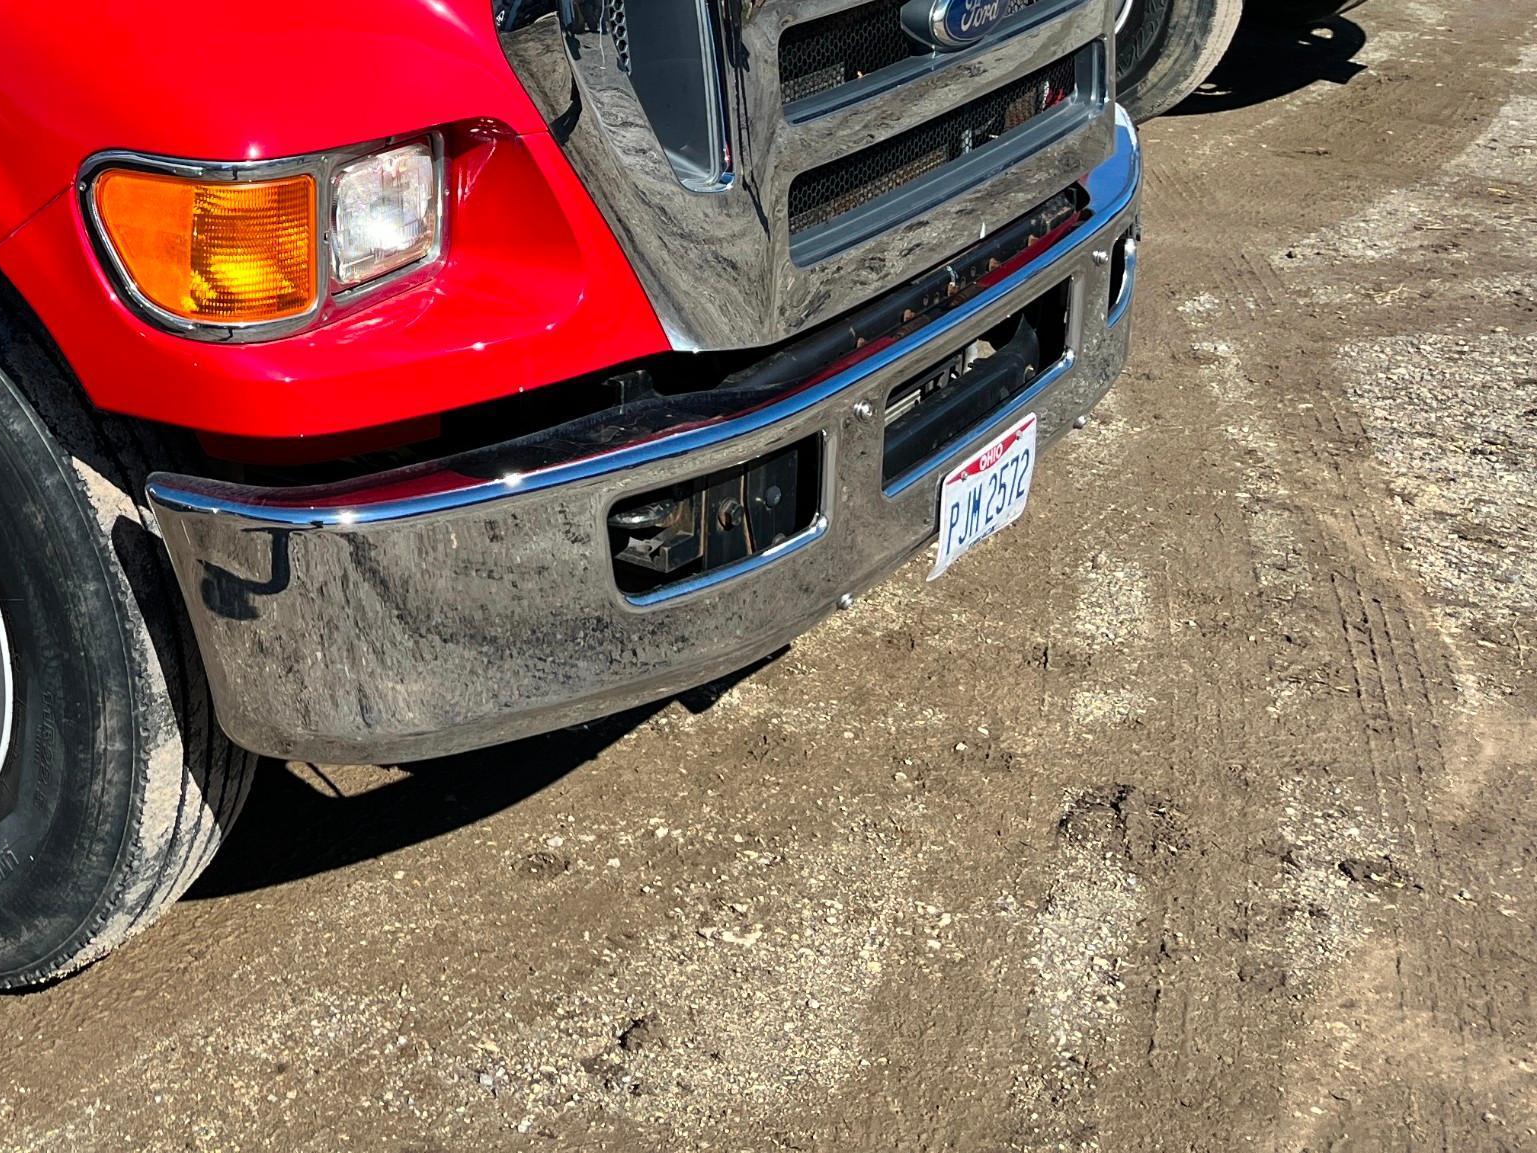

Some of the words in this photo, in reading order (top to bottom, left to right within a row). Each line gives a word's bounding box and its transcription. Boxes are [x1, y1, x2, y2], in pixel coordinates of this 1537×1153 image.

[979, 442, 1003, 471] OHIO
[945, 482, 983, 556] PJM
[985, 448, 1030, 526] 2572
